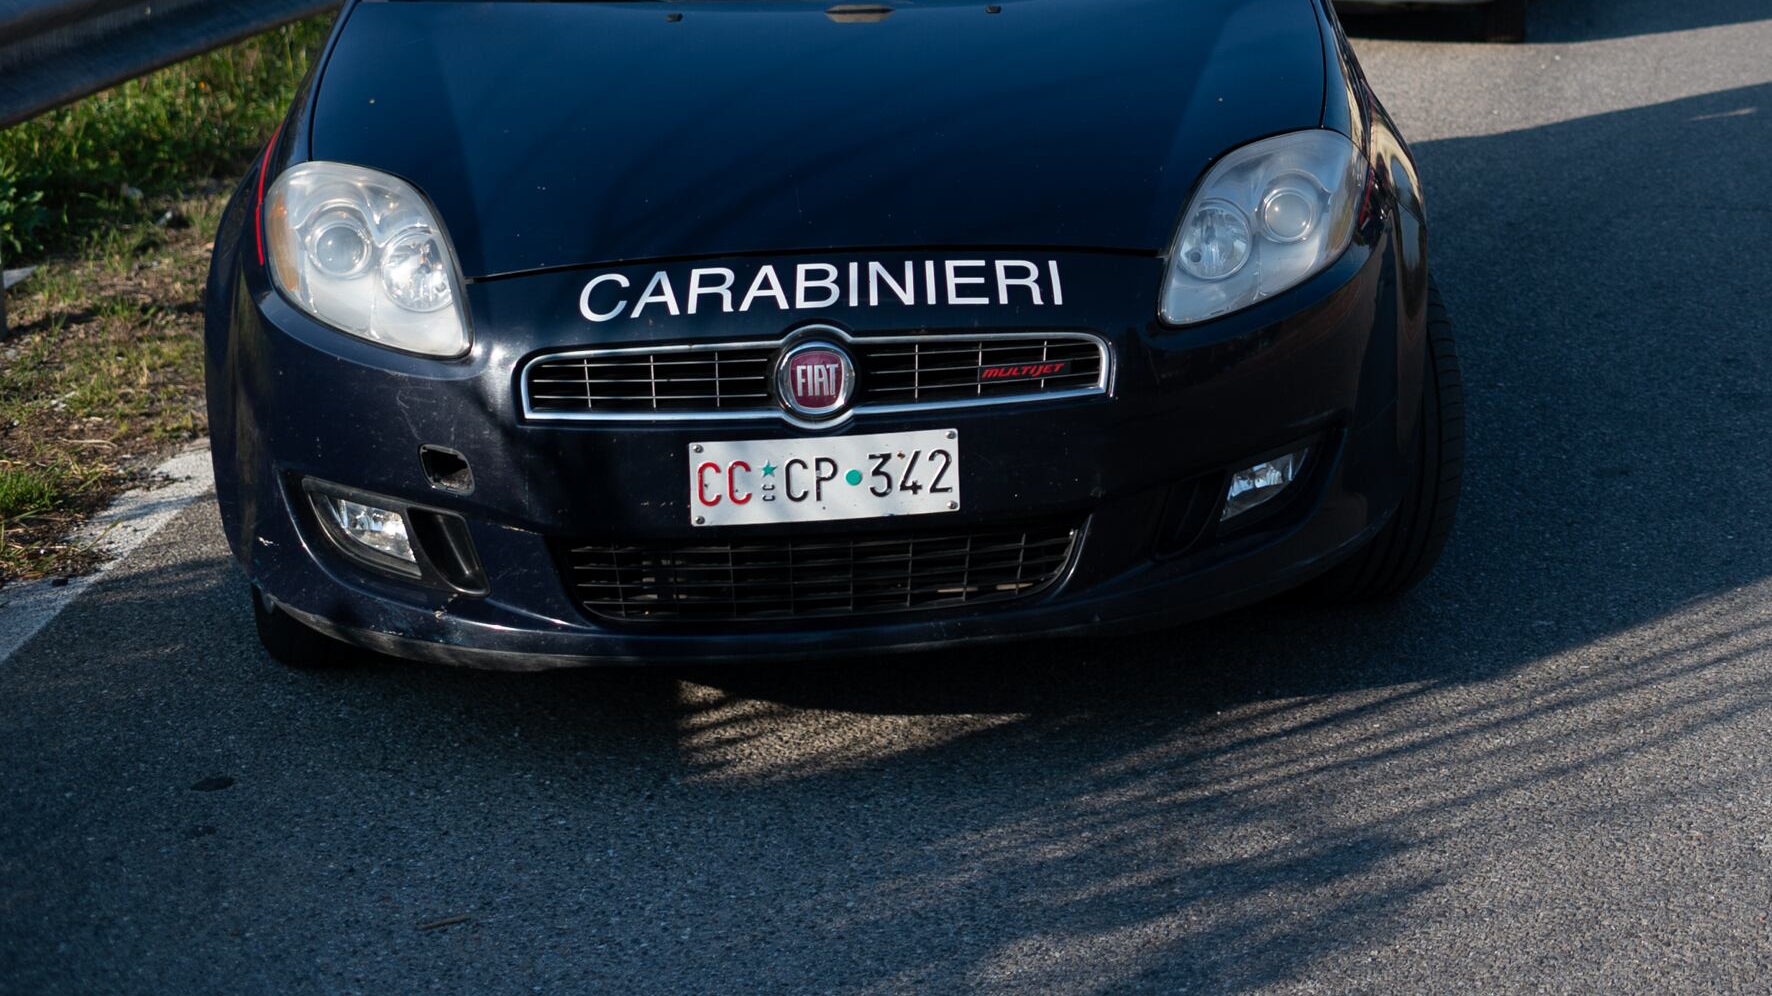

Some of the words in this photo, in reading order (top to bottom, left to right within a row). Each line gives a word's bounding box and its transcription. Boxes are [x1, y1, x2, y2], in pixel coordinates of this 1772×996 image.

[579, 259, 1064, 322] CARABINIERI
[796, 363, 839, 398] FIAT
[981, 361, 1067, 380] MULTIJET
[697, 460, 752, 507] CC
[784, 457, 838, 503] CP
[867, 448, 953, 498] 342
